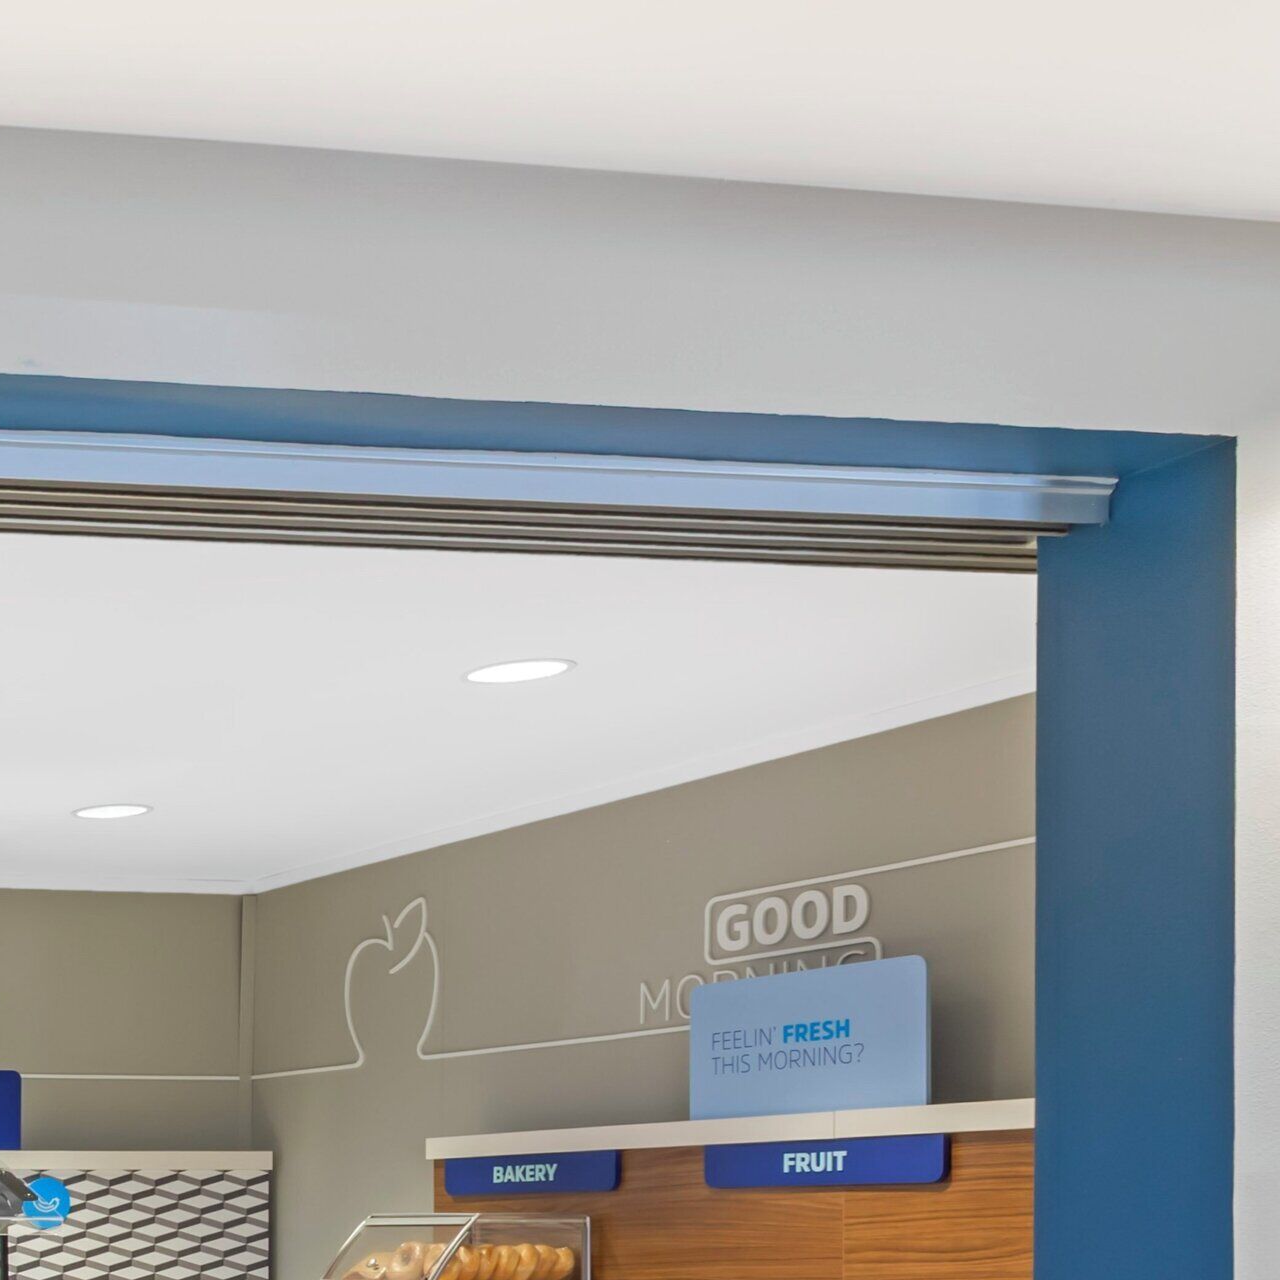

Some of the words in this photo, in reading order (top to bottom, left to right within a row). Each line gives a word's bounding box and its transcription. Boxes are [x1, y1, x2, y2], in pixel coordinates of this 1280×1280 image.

[716, 883, 869, 952] GOOD
[782, 1018, 850, 1044] FRESH
[711, 1053, 751, 1076] THIS
[757, 1042, 865, 1072] MORNING?
[492, 1163, 558, 1184] BAKERY
[782, 1150, 848, 1174] FRUIT
